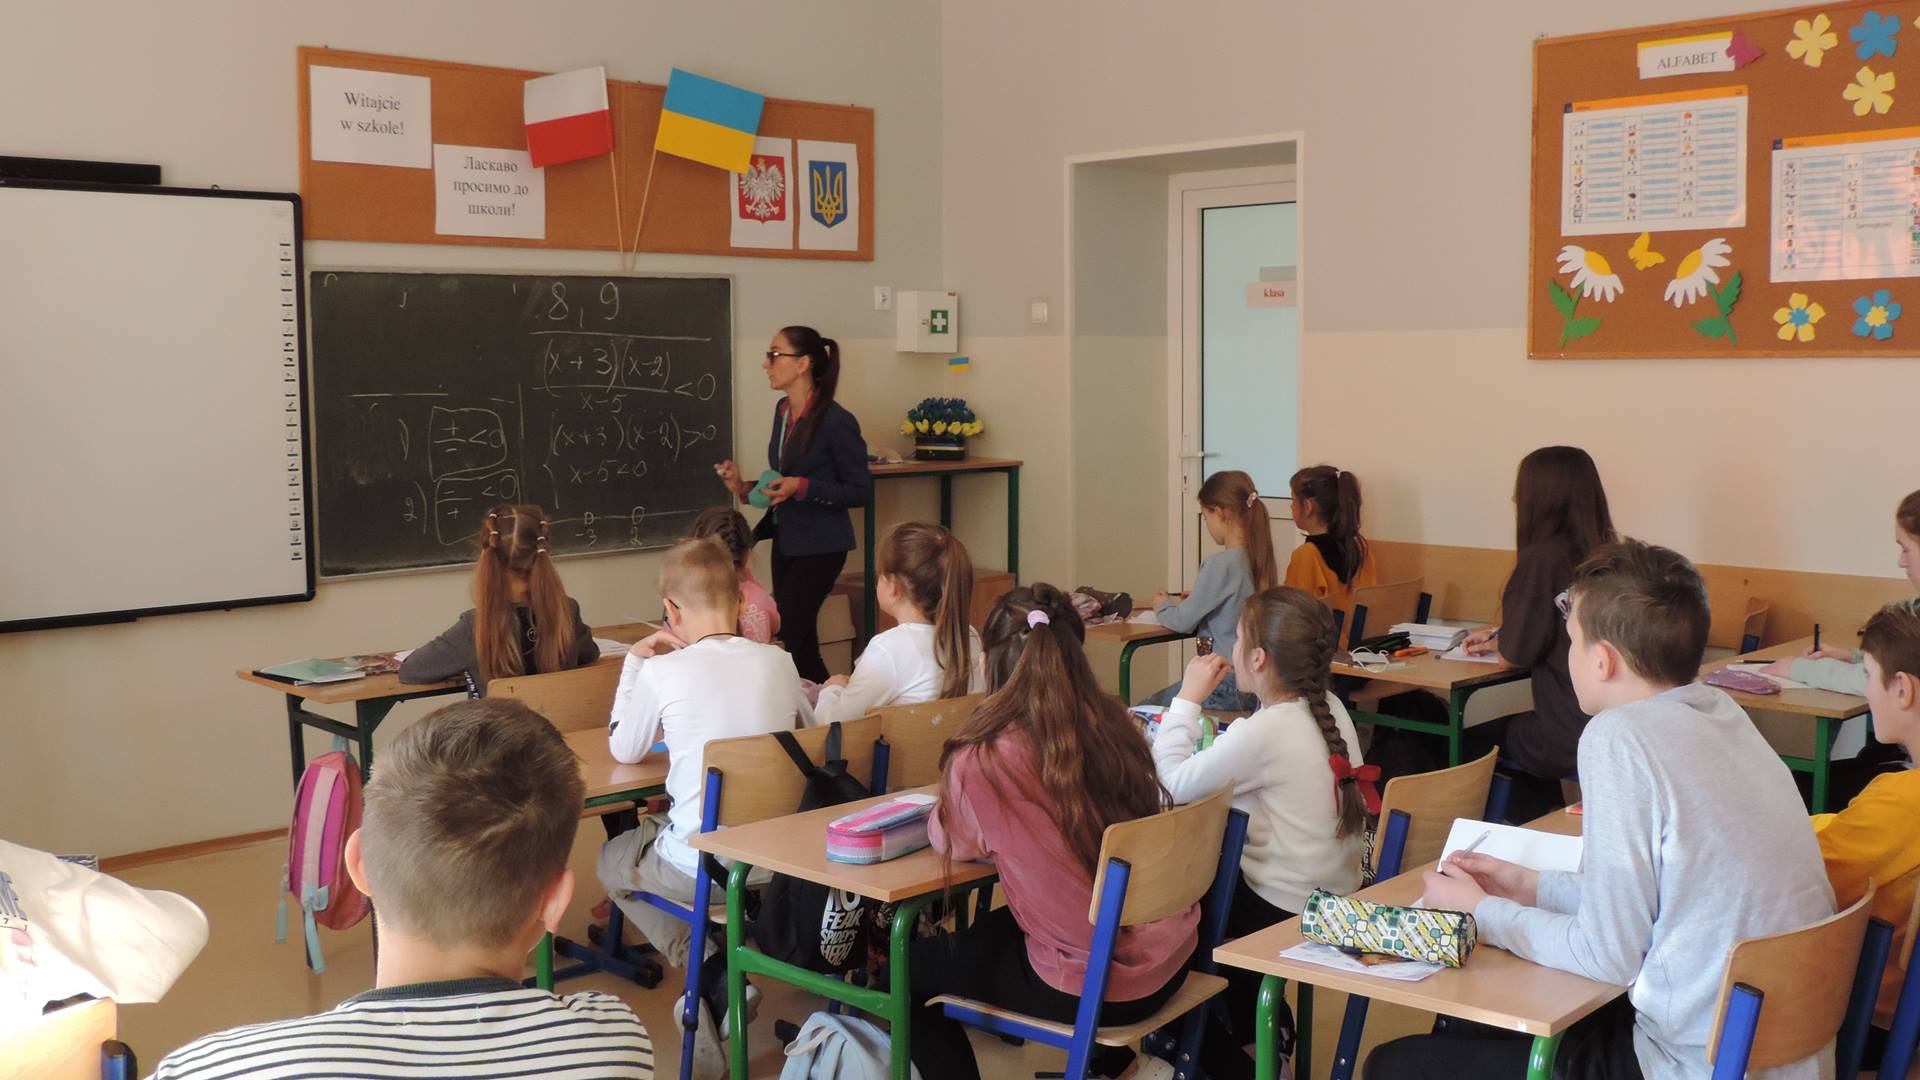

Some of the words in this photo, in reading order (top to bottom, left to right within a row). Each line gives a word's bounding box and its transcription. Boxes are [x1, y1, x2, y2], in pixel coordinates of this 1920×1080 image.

[1657, 51, 1717, 69] ALFABET
[344, 91, 401, 112] Witajcie
[340, 120, 351, 130] w
[358, 119, 405, 136] szkole!
[463, 156, 519, 173] Ласкаво
[453, 180, 510, 195] просимо
[513, 184, 529, 196] до
[468, 203, 516, 217] школи!
[1264, 288, 1285, 298] klasa
[822, 907, 865, 930] FEAR
